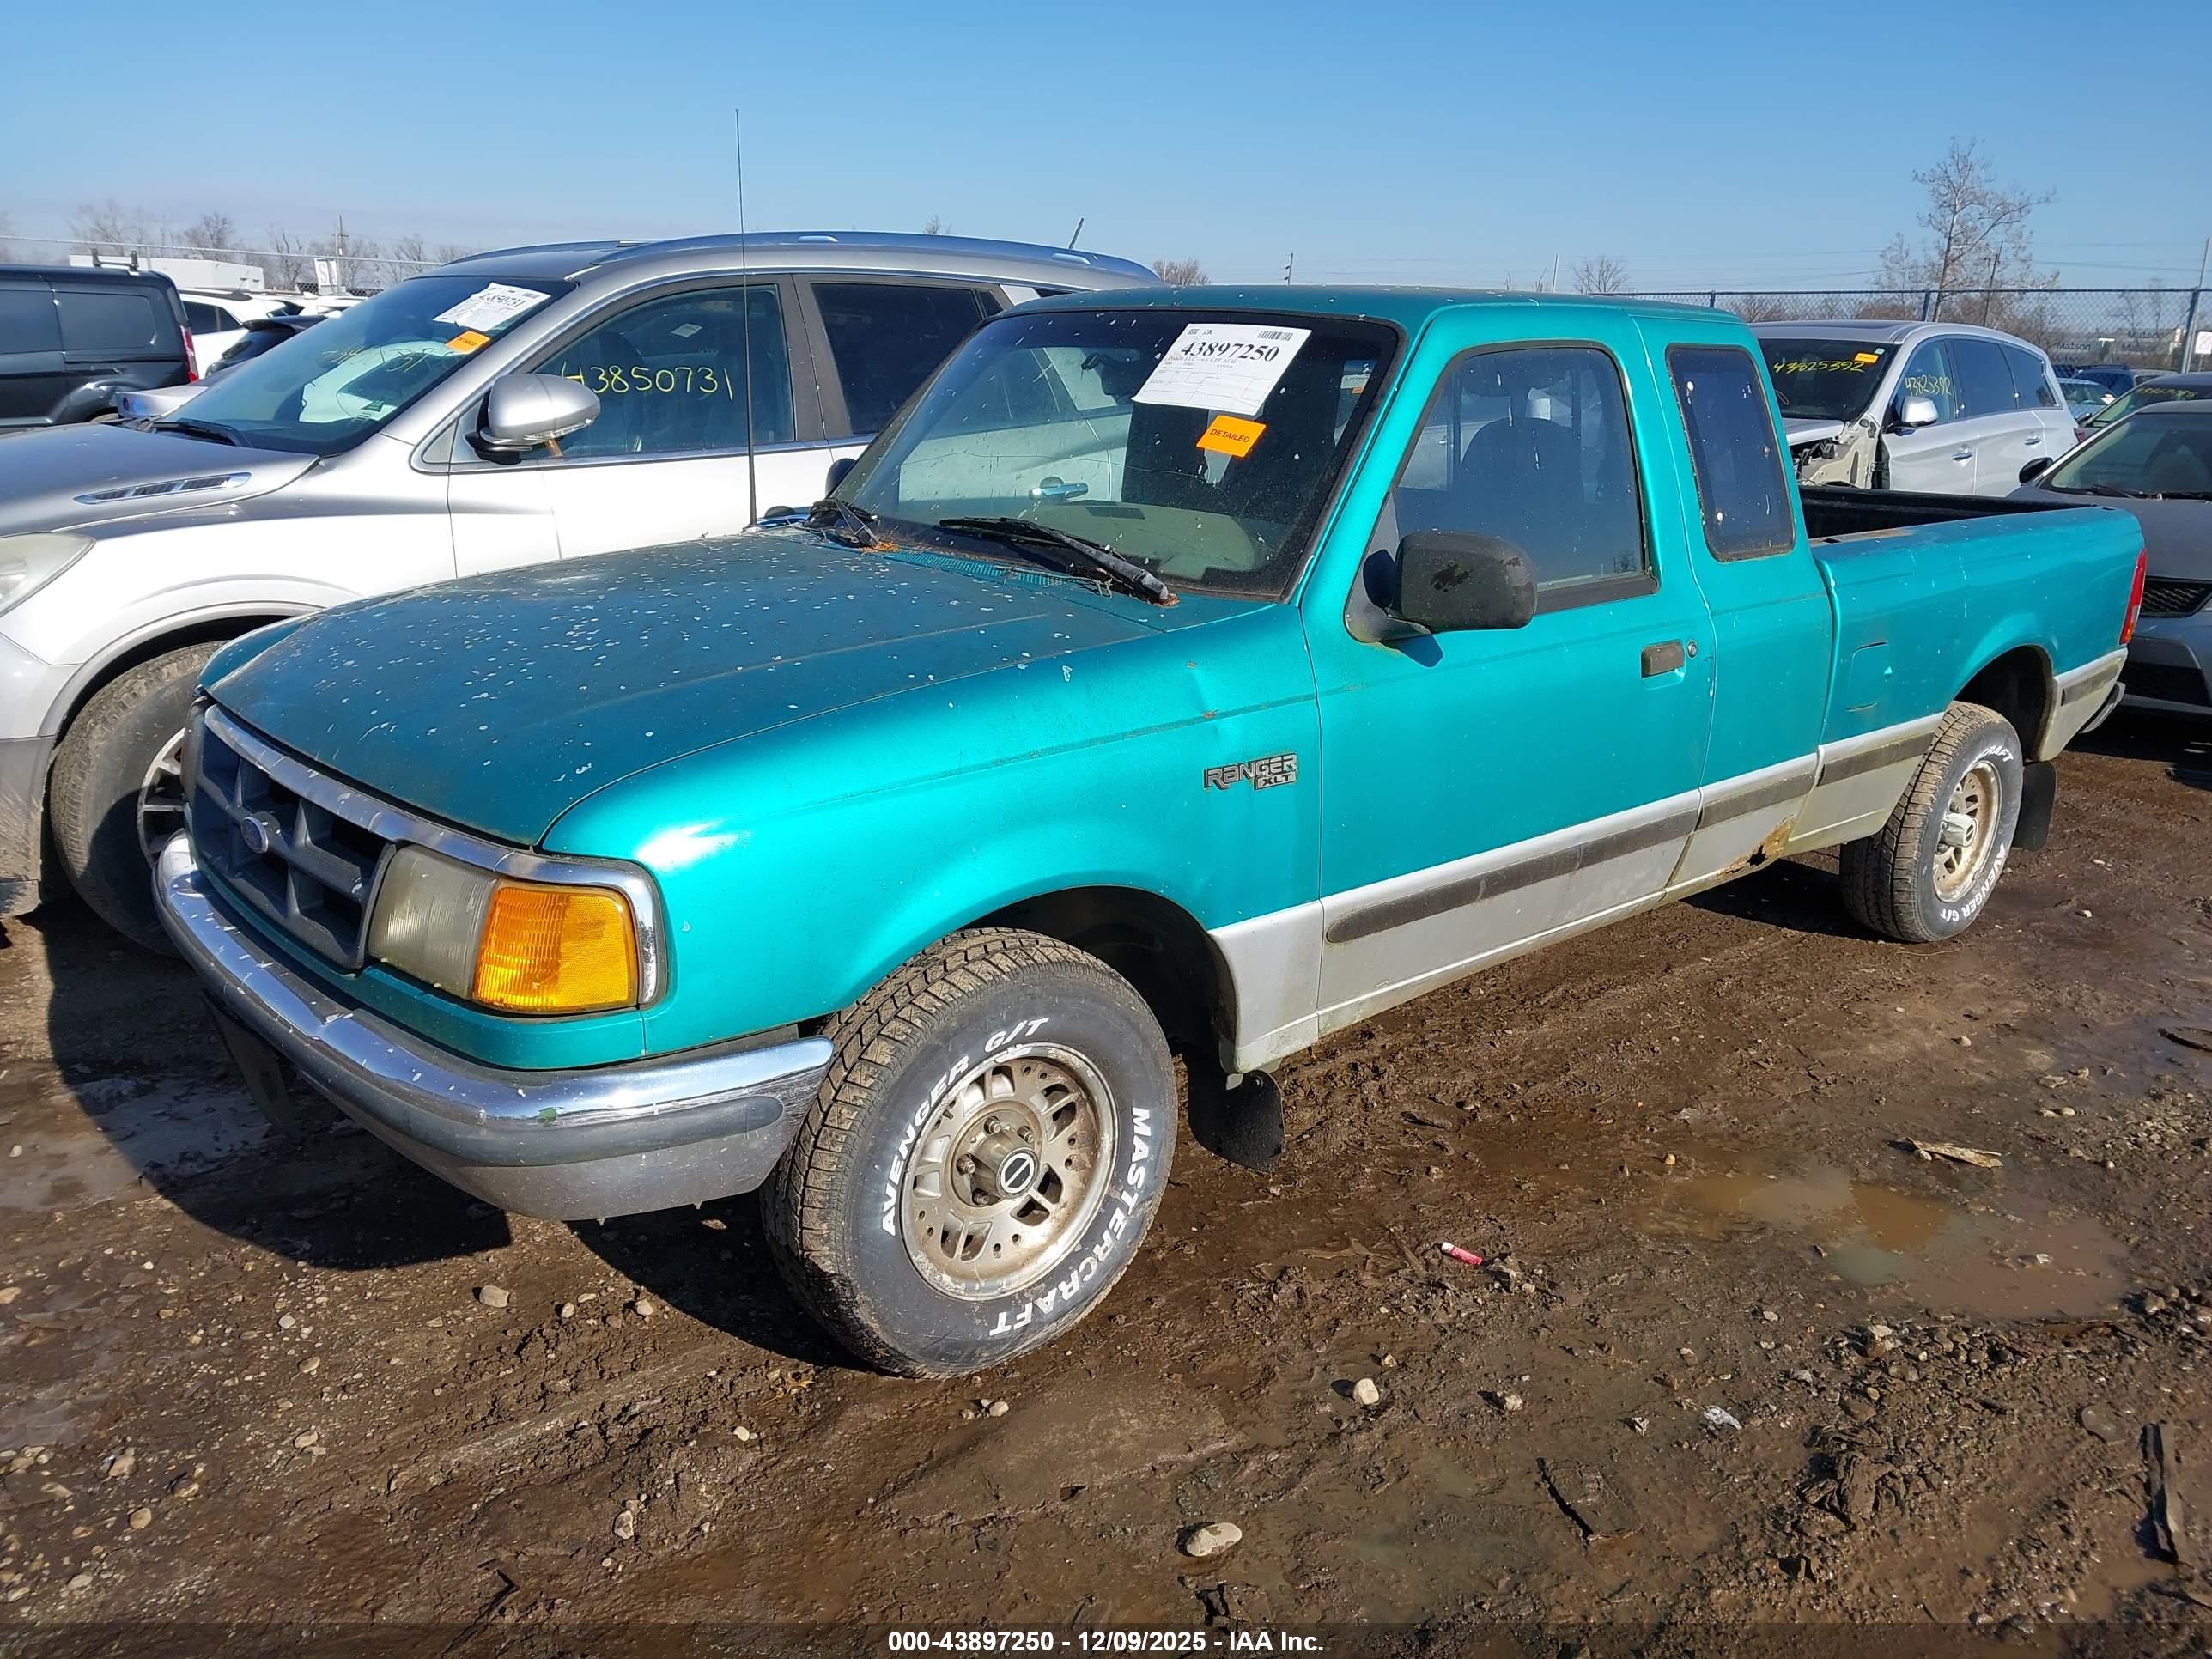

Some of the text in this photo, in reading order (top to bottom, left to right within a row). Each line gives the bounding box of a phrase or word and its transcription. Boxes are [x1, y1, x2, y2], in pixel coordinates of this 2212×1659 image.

[1181, 341, 1280, 362] 43897250
[561, 362, 733, 402] 43850731
[1209, 428, 1251, 443] DETAILED
[1260, 773, 1293, 787] XLT
[1961, 842, 2006, 918] AVENGER
[882, 1017, 1049, 1237] AVENGER G/T
[989, 1107, 1152, 1337] MASTERCRAFT
